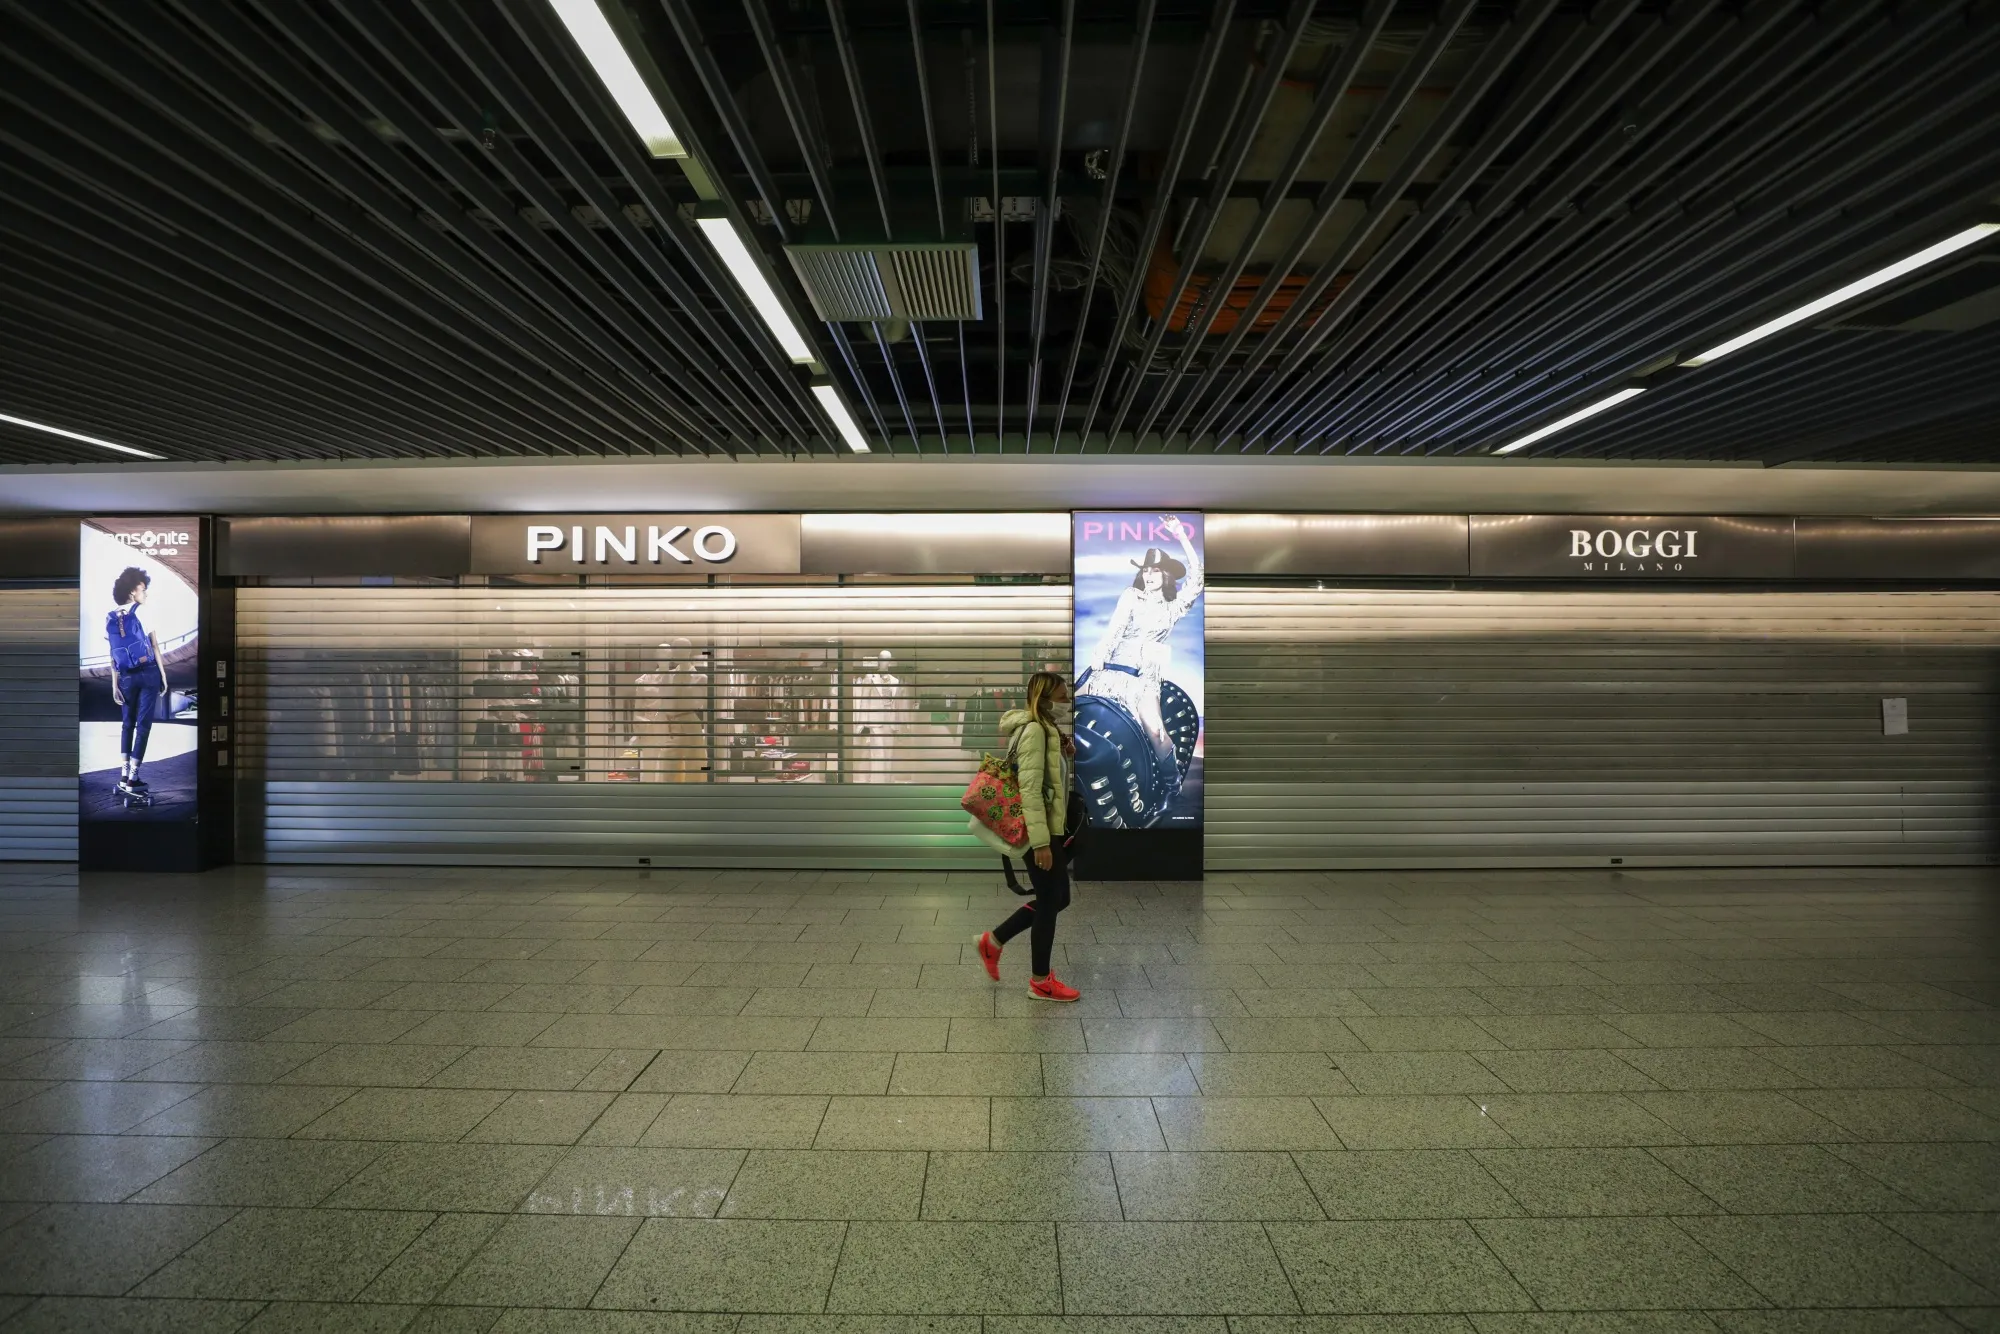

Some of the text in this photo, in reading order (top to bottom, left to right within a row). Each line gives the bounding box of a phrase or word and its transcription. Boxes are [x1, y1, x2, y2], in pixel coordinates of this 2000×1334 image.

[102, 530, 189, 547] msonite
[527, 525, 736, 562] PINKO
[1569, 529, 1698, 558] BOGGI
[160, 548, 178, 556] GO
[1583, 562, 1683, 572] MILANO
